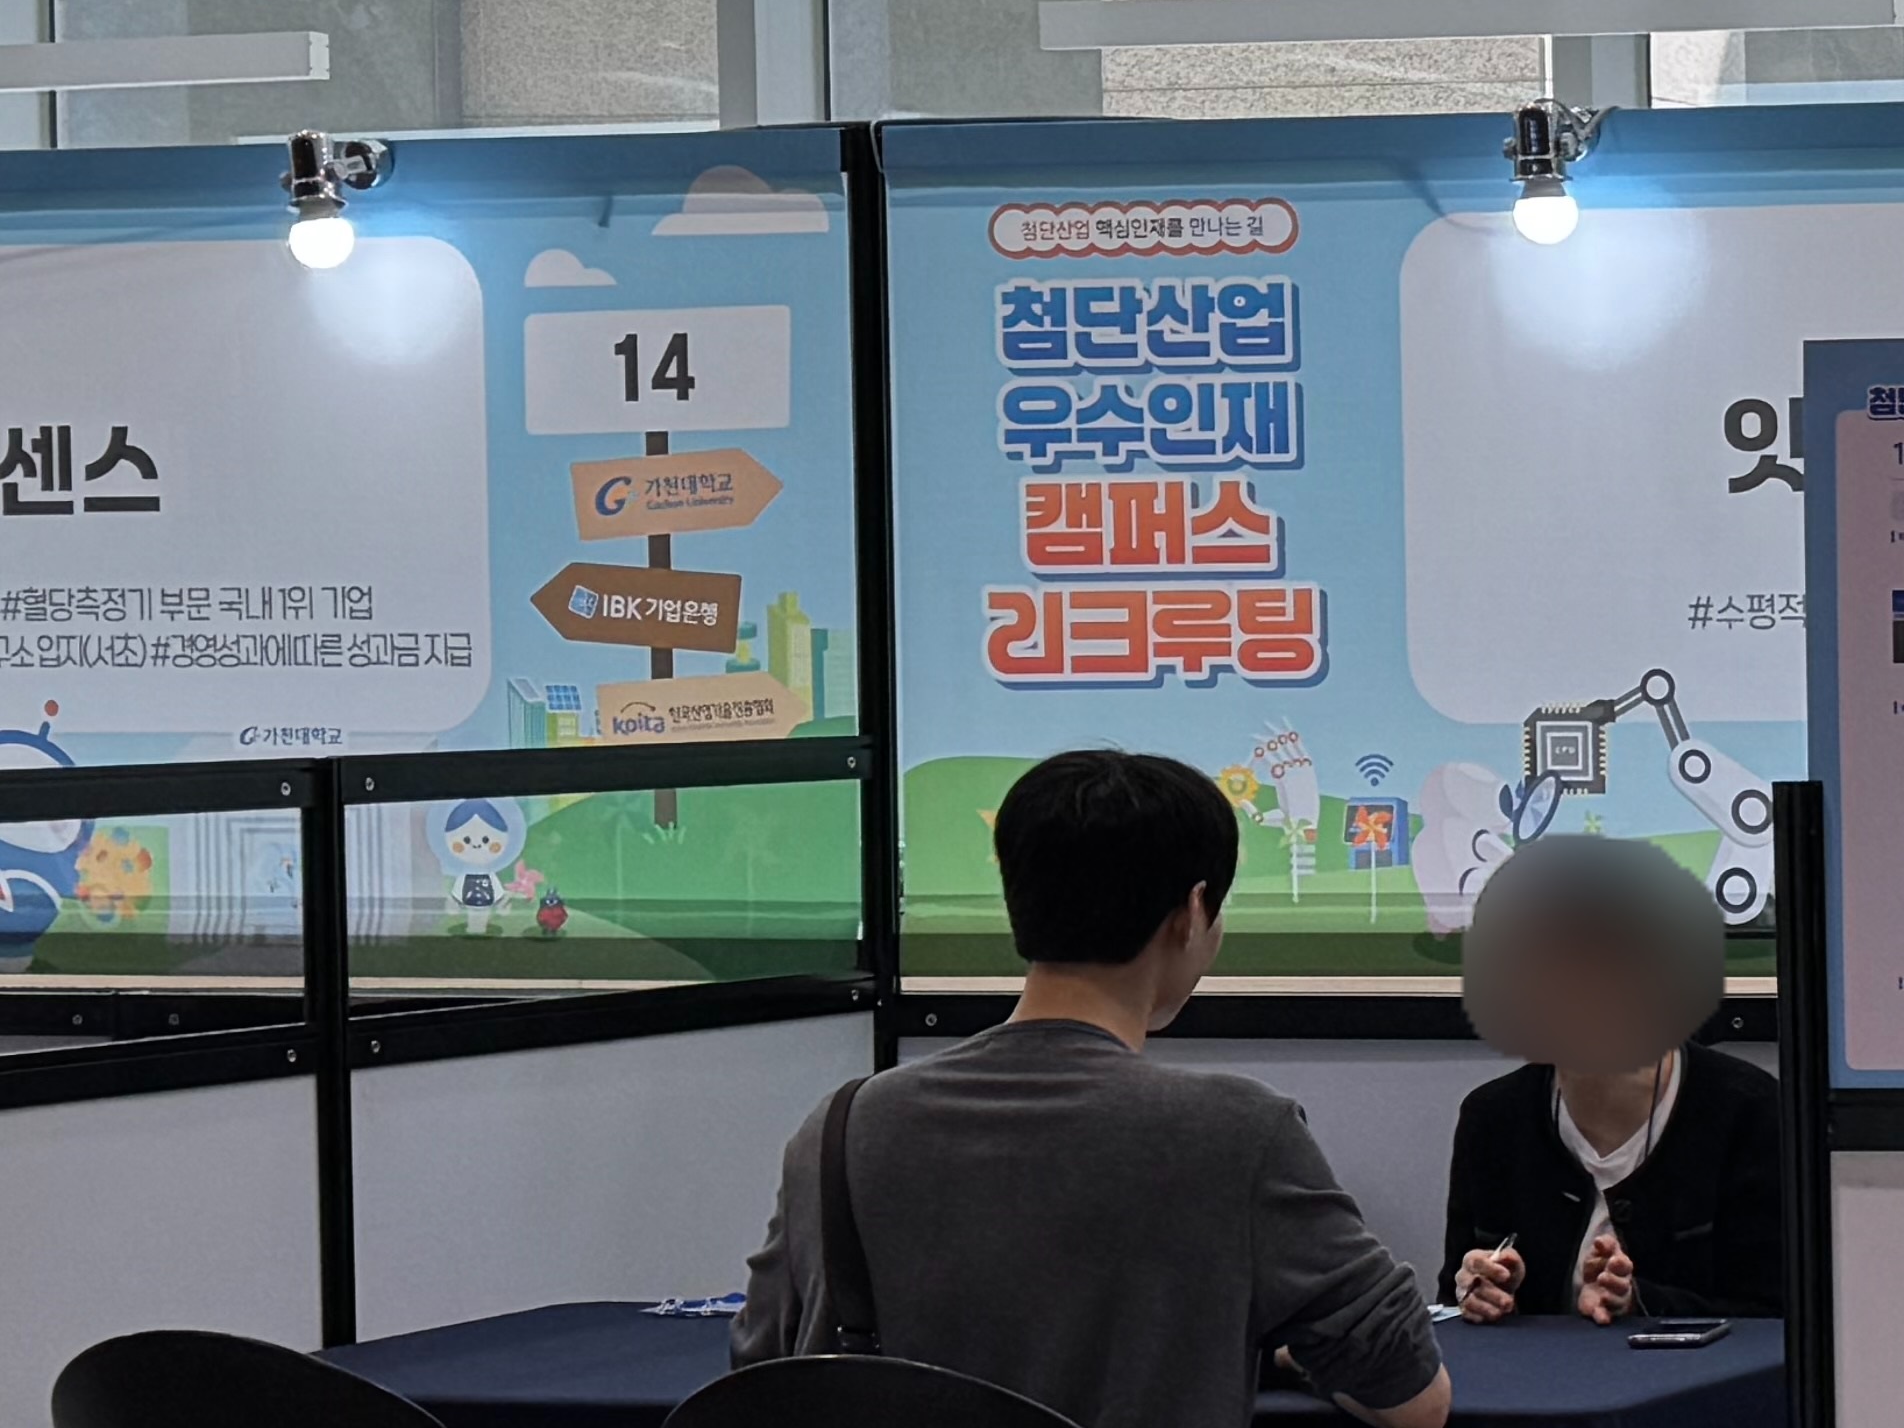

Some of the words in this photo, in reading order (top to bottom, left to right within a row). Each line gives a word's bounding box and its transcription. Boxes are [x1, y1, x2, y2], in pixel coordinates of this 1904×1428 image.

[1020, 221, 1090, 242] 첨단산업
[1188, 216, 1243, 238] 만나는
[1247, 215, 1265, 237] 길
[1000, 282, 1286, 361] 첨단산업
[613, 332, 696, 402] 14
[1002, 380, 1290, 458] 우수인재
[0, 425, 160, 514] 센스
[1025, 481, 1271, 566] 캠퍼스
[0, 586, 152, 622] #혈당측정기
[160, 587, 212, 622] 부문
[321, 586, 373, 621] 기업
[988, 588, 1315, 674] 리크루팅
[263, 727, 342, 746] 가천대학교
